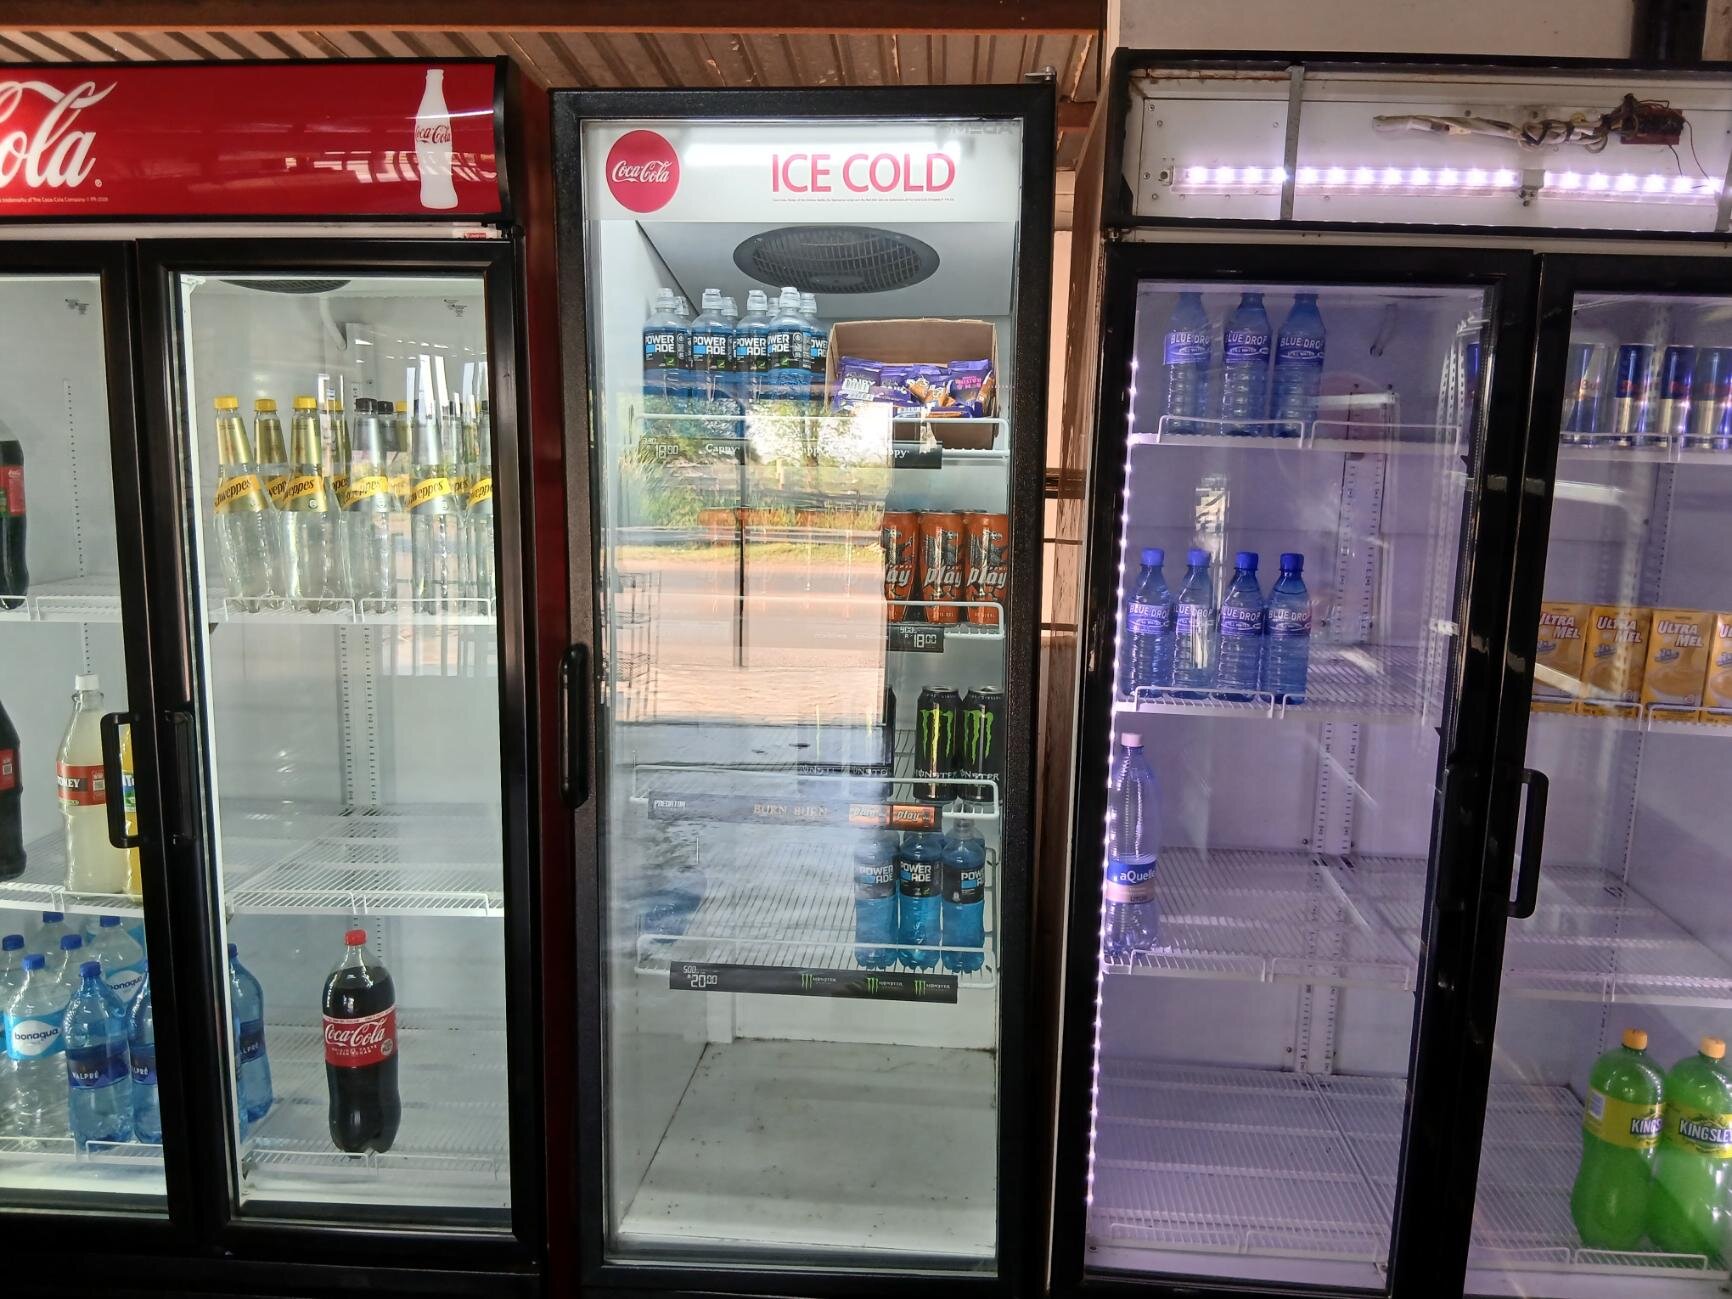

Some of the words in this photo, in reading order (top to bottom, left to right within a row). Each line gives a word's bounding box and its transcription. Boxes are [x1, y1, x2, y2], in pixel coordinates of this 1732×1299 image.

[611, 160, 673, 183] Coca-Cola
[771, 153, 832, 193] ICE
[842, 152, 956, 193] COLD
[693, 336, 726, 346] POWER
[1170, 334, 1192, 344] BLUE
[1280, 337, 1302, 347] BLUE
[655, 343, 675, 353] ADE
[706, 345, 726, 356] ADE
[746, 346, 767, 356] ADE
[1129, 606, 1149, 615] BLUE
[1268, 610, 1289, 620] BLUE
[1597, 616, 1638, 632] ULTRA
[1658, 620, 1698, 635] ULTRA
[1553, 626, 1580, 639] MEL
[1615, 630, 1642, 643] MEL
[1675, 634, 1703, 647] MEL
[859, 864, 894, 876] POWER
[900, 860, 932, 874] POWER
[875, 874, 894, 884] ADE
[911, 872, 932, 882] ADE
[14, 1027, 59, 1042] bonaqua
[325, 1017, 388, 1048] Coca-Cola
